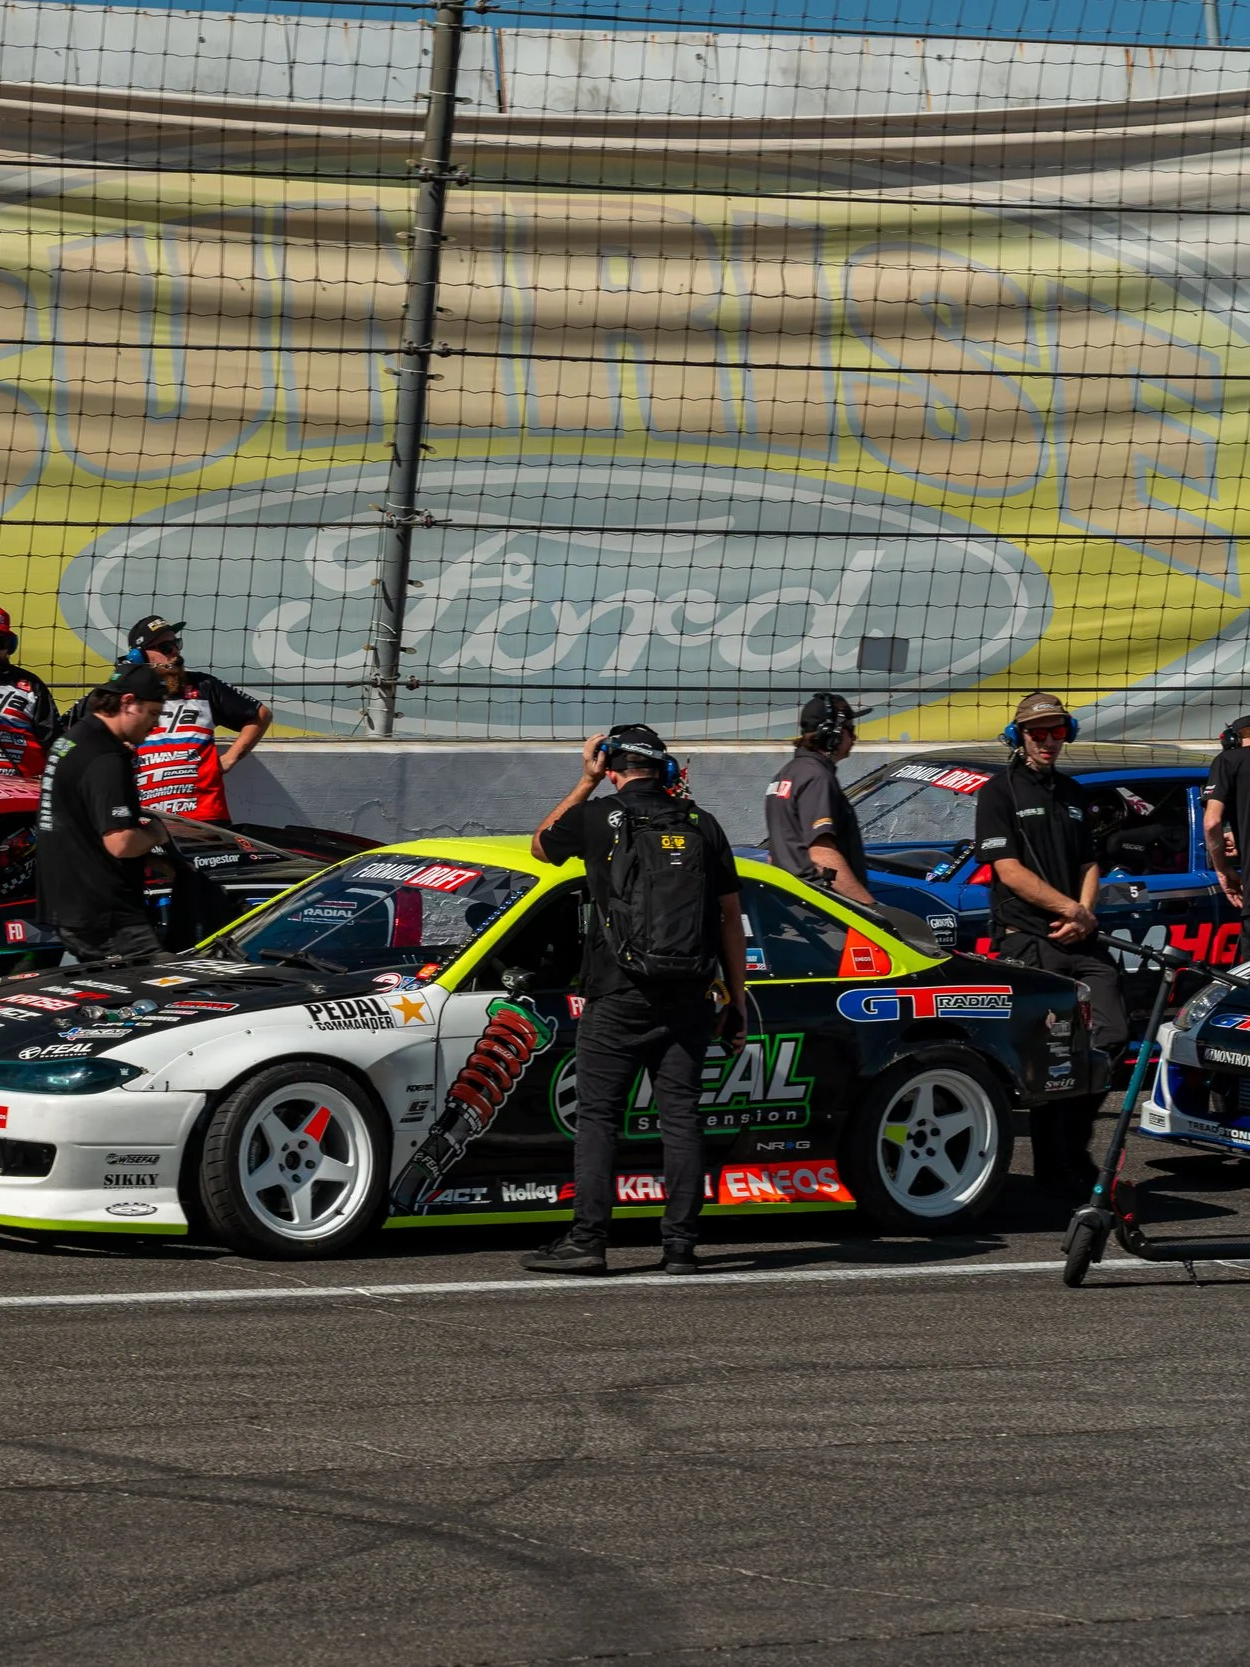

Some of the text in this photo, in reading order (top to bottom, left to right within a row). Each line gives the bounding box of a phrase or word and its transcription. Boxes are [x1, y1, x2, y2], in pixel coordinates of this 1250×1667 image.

[250, 508, 887, 680] Ford
[163, 768, 198, 777] RADIAL
[890, 764, 990, 793] FORMULA DRIFT
[193, 854, 240, 868] forgestar
[352, 863, 476, 890] FORMULA DRIFT
[1129, 886, 1139, 898] 5
[303, 907, 354, 918] RADIAL
[8, 923, 23, 940] FD
[1169, 922, 1245, 965] HG
[304, 998, 393, 1022] PEDAL
[837, 985, 1013, 1022] GT RADIAL
[316, 1016, 395, 1031] COMMANDER
[41, 1043, 94, 1055] FEAL
[1044, 1078, 1076, 1088] Swift
[637, 1109, 798, 1131] Sension
[118, 1153, 161, 1165] WISEFAB
[421, 1155, 441, 1178] FEAL
[103, 1173, 159, 1186] SIKKY
[726, 1167, 840, 1198] ENEOS
[440, 1187, 488, 1203] ACT
[502, 1182, 558, 1208] Holley
